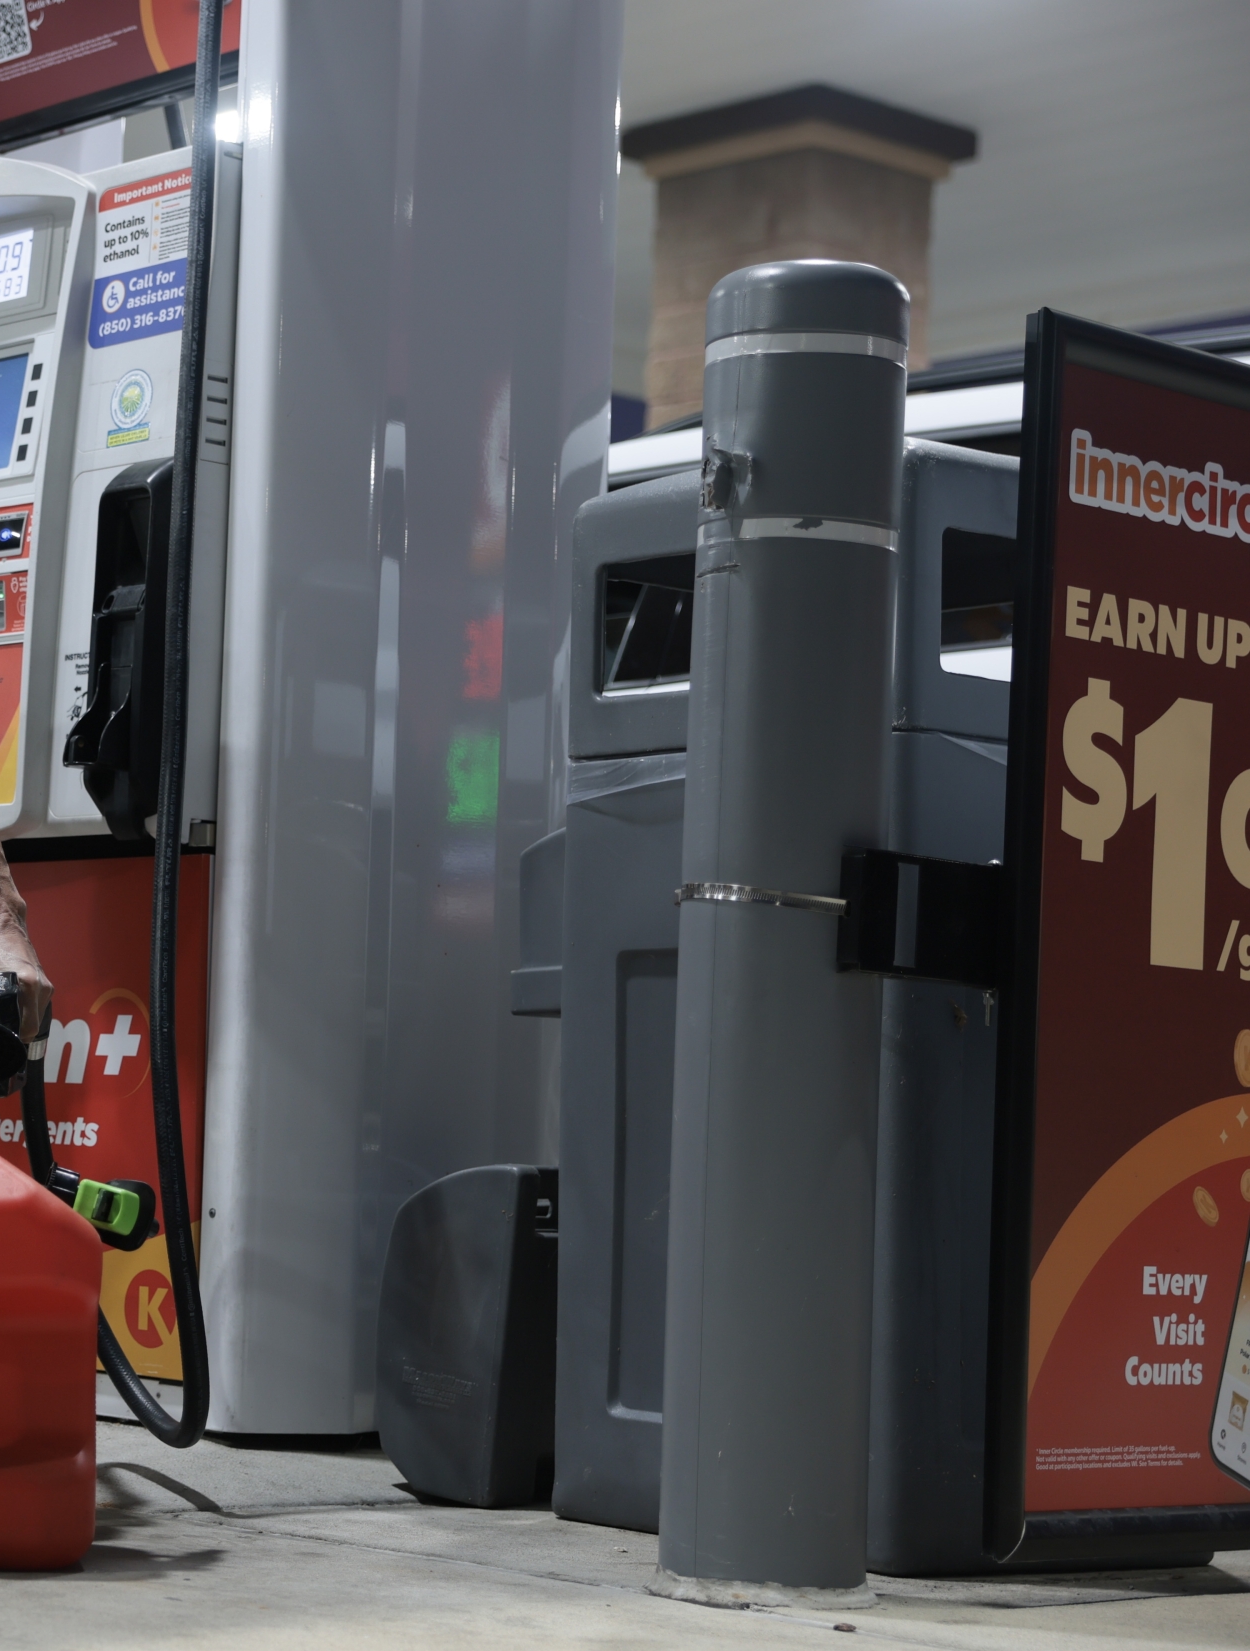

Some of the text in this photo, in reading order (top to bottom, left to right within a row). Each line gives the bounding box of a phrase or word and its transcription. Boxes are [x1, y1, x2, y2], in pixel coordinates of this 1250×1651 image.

[113, 183, 163, 203] Important
[104, 215, 145, 234] Contains
[104, 236, 116, 249] up
[118, 234, 128, 245] to
[129, 228, 149, 243] 10%
[103, 244, 140, 263] ethanol
[128, 269, 176, 292] Call for
[98, 318, 131, 337] (850)
[1065, 585, 1250, 669] EARN UP
[1142, 1265, 1208, 1304] Every
[137, 1286, 174, 1338] K
[1153, 1313, 1205, 1346] Visit
[1125, 1356, 1203, 1386] Counts
[1064, 1447, 1091, 1455] membership
[1135, 1445, 1150, 1454] gallons
[1123, 1453, 1146, 1461] Qualifying
[1054, 1462, 1082, 1471] participating
